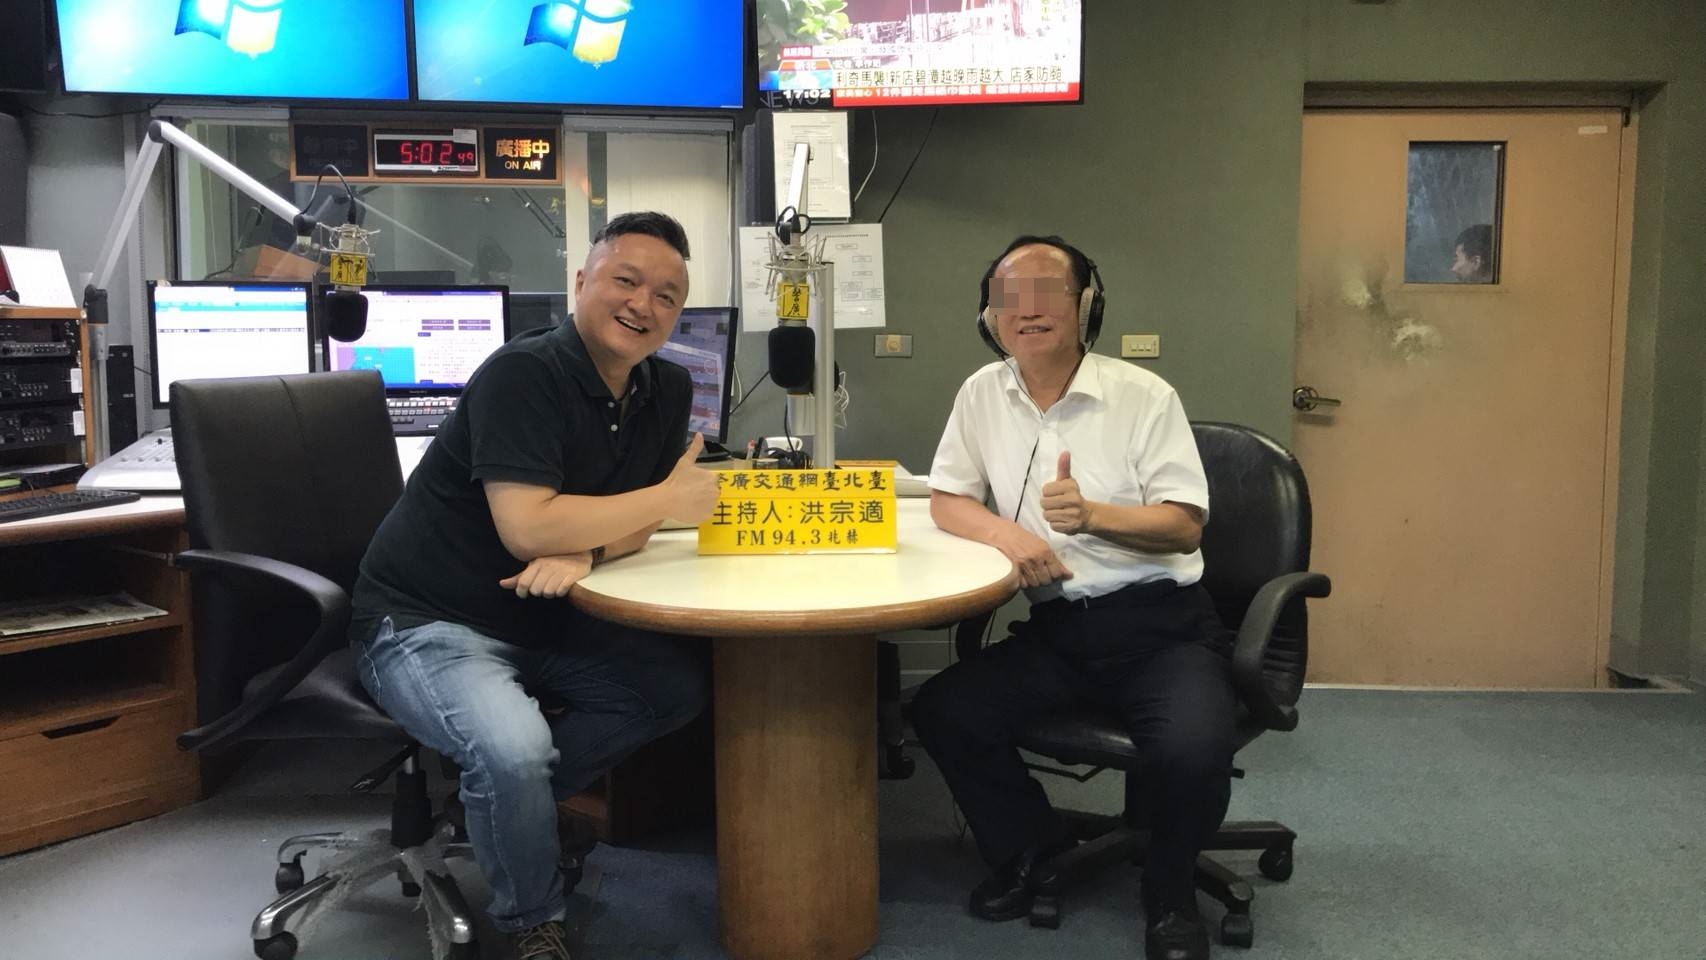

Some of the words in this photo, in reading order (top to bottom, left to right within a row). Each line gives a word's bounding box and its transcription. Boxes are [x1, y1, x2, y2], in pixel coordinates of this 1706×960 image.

[783, 89, 831, 99] 17:02
[400, 142, 453, 164] 5:02
[457, 152, 474, 163] 49
[495, 139, 550, 159] 廣播中
[504, 160, 519, 170] ON
[522, 160, 541, 171] AIR
[712, 499, 885, 526] 主持人:洪宗適
[827, 529, 859, 545] 兆赫
